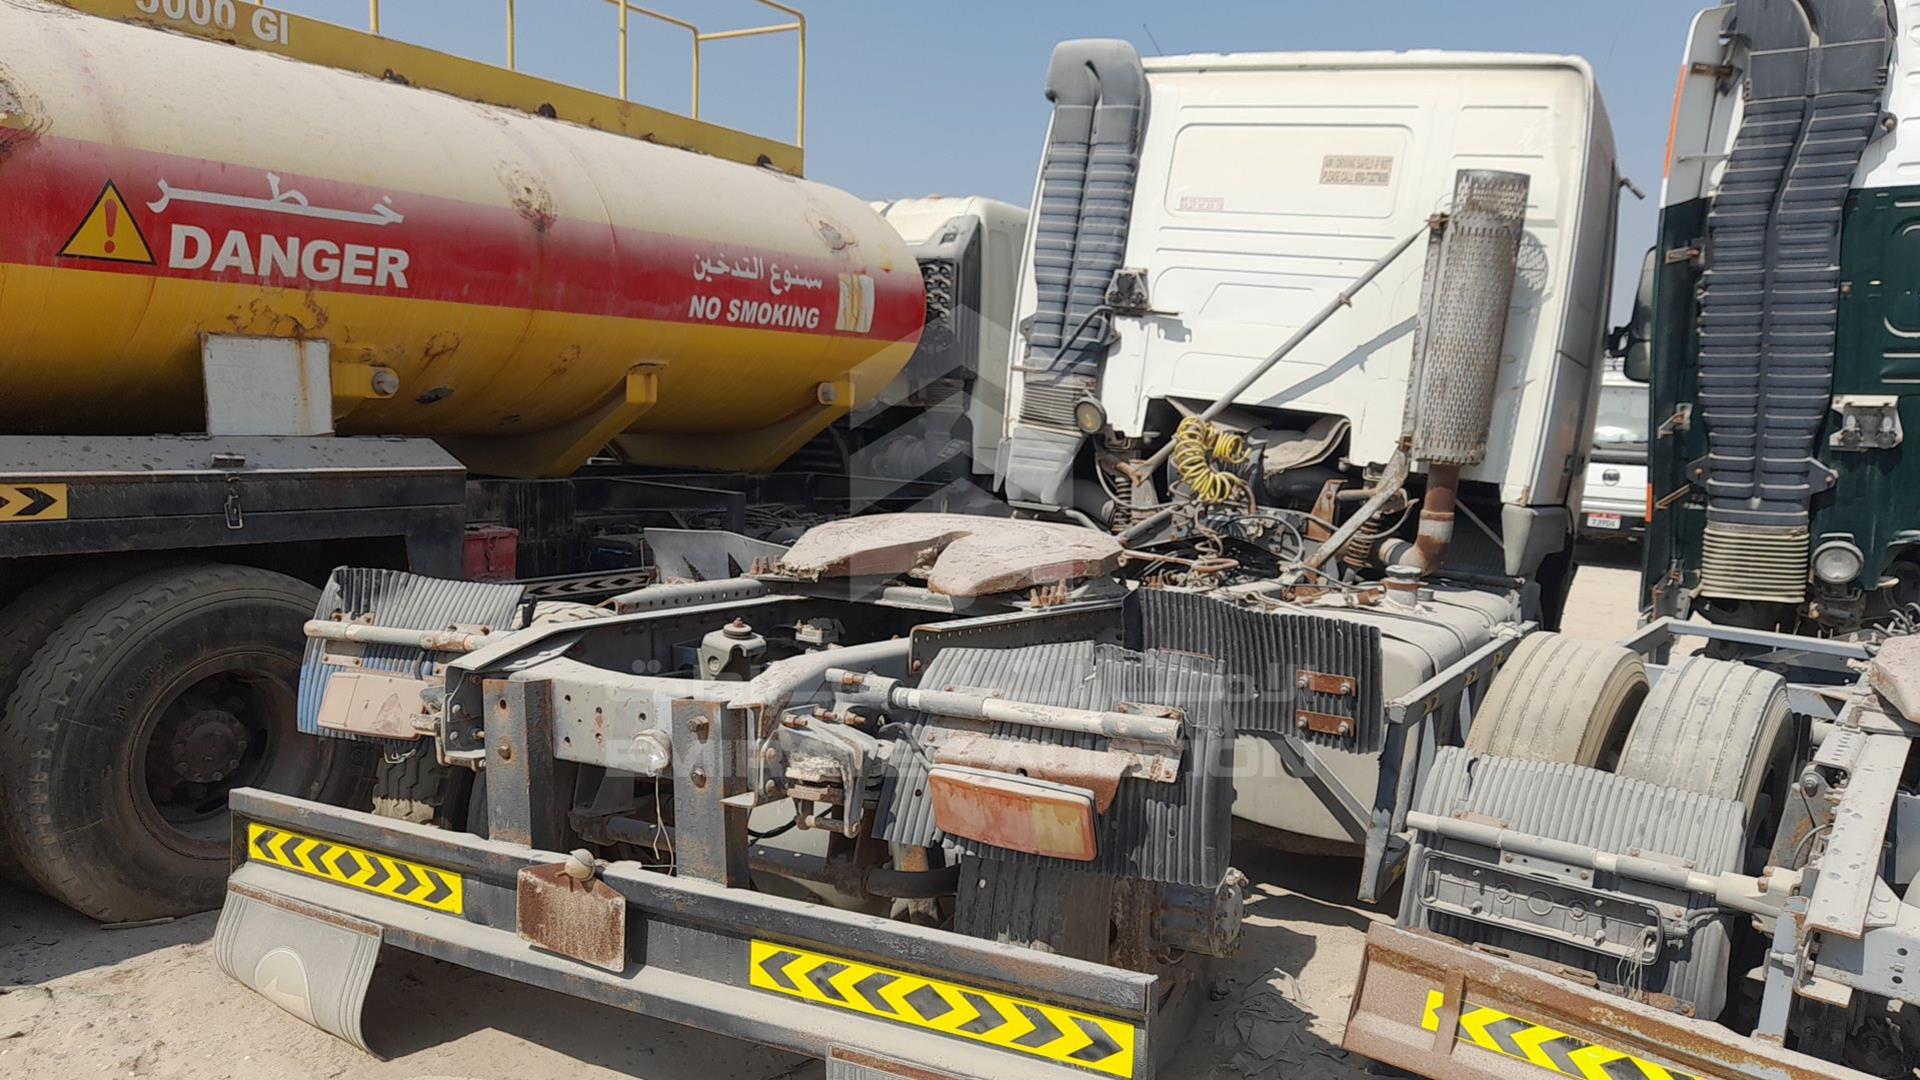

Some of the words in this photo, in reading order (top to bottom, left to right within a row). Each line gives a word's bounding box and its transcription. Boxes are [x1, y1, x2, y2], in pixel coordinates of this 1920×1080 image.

[146, 171, 405, 226] خطر
[168, 223, 410, 289] DANGER
[693, 252, 764, 282] التدخين
[688, 294, 722, 320] NO
[726, 298, 821, 330] SMOKING
